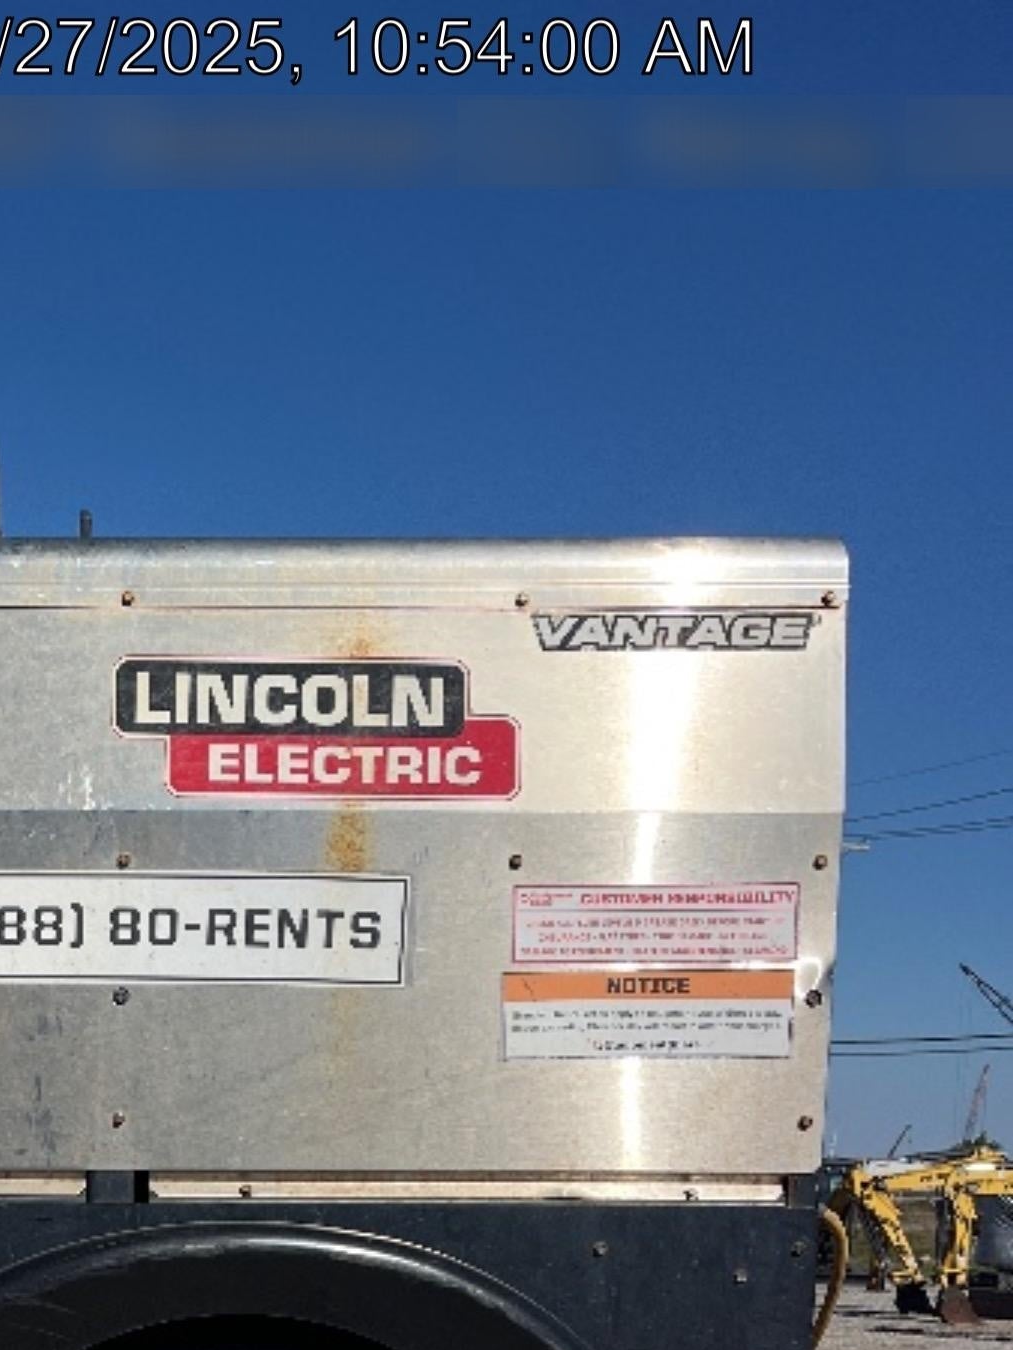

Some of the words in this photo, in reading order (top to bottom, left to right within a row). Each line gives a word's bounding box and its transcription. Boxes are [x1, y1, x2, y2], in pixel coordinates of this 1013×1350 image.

[532, 614, 813, 651] VANTAGE
[134, 671, 444, 727] LINCOLN
[208, 743, 482, 786] ELECTRIC
[109, 907, 381, 949] 80-RENTS
[607, 977, 691, 994] NOTICE
